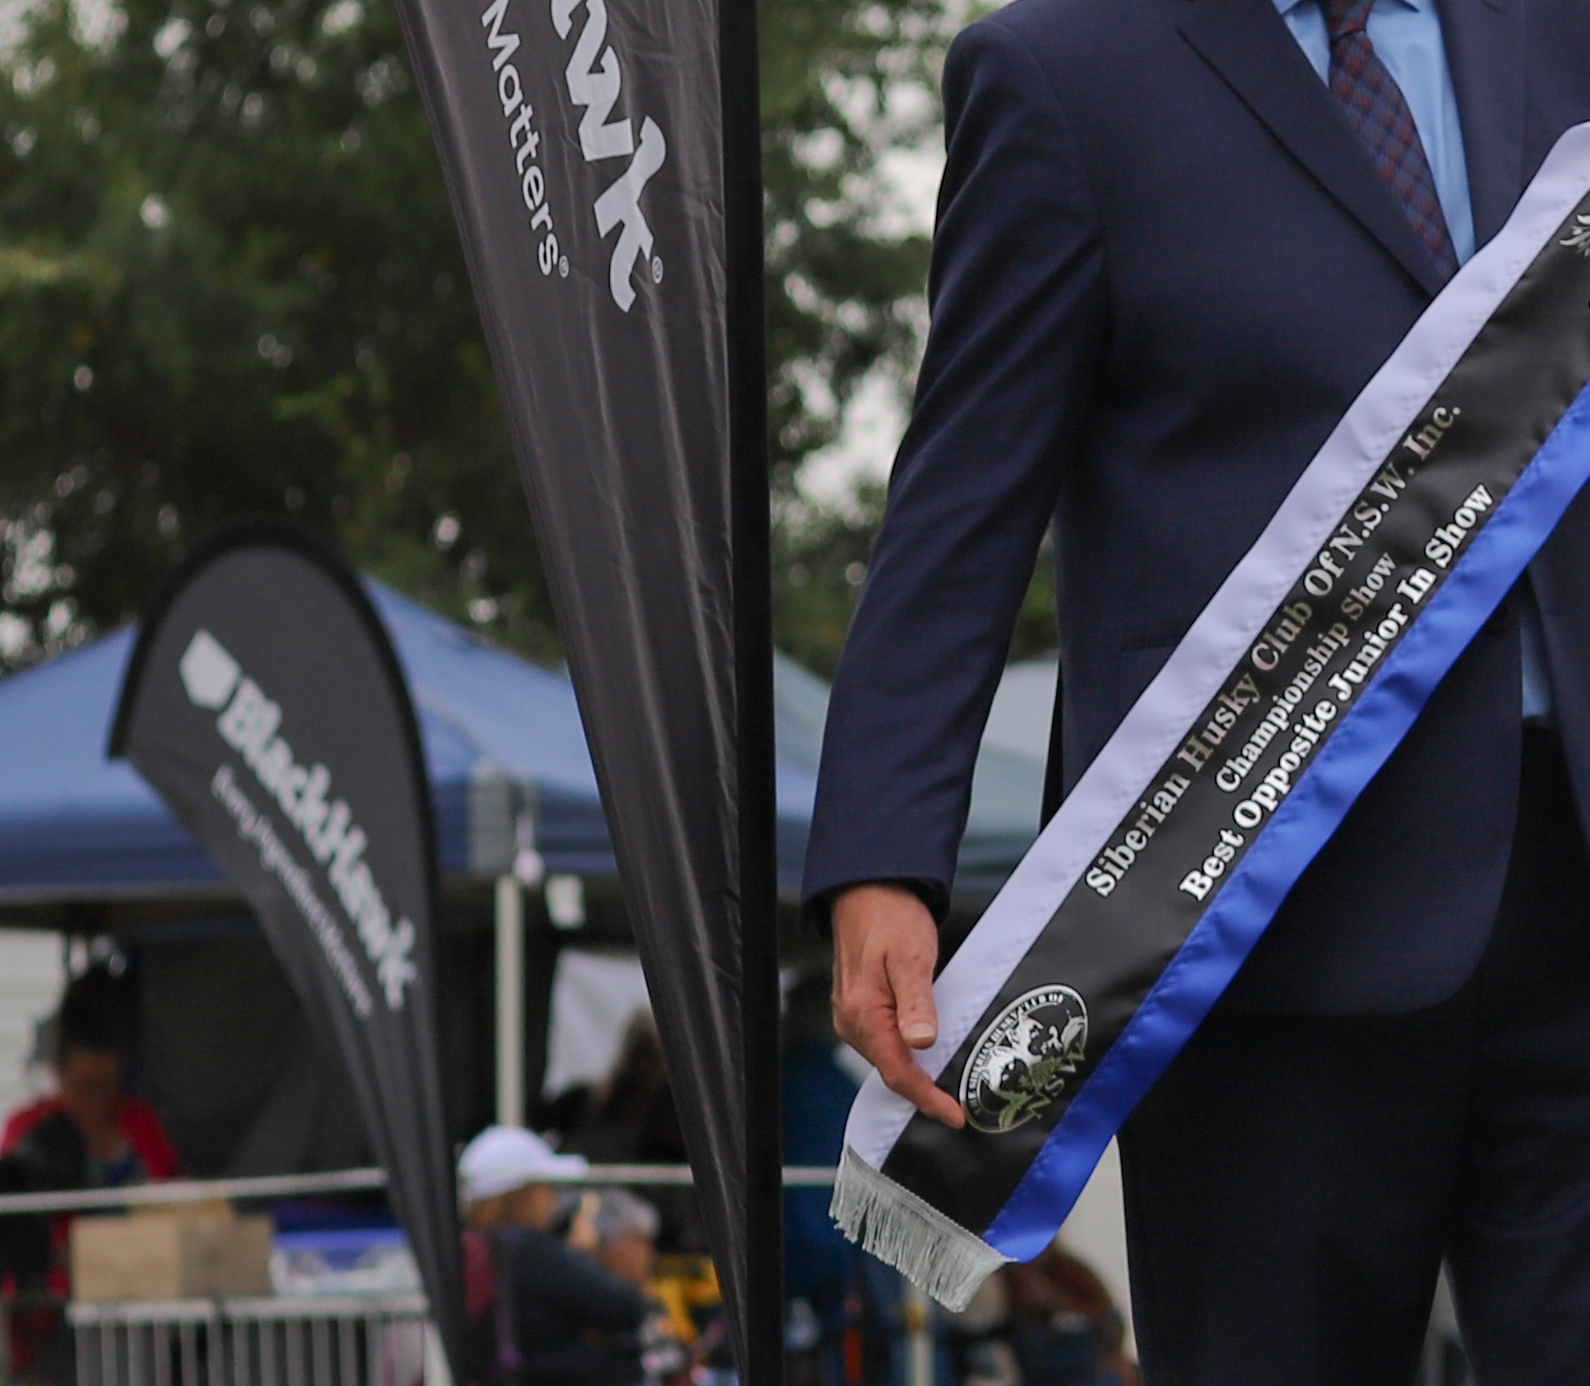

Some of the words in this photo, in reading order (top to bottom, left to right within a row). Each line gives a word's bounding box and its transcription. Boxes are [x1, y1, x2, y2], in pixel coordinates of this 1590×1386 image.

[1085, 772, 1190, 897] Siberian
[1178, 672, 1262, 773] Husky
[1251, 601, 1313, 673] Club
[1303, 550, 1346, 598] Of
[1402, 403, 1461, 462] Inc.
[1179, 830, 1245, 902] Best
[1233, 699, 1338, 830] Opposite
[1328, 603, 1409, 702] Junior
[1397, 568, 1437, 605] In
[1424, 483, 1495, 568] Show
[1215, 622, 1350, 793] Championship
[1340, 551, 1397, 620] Show
